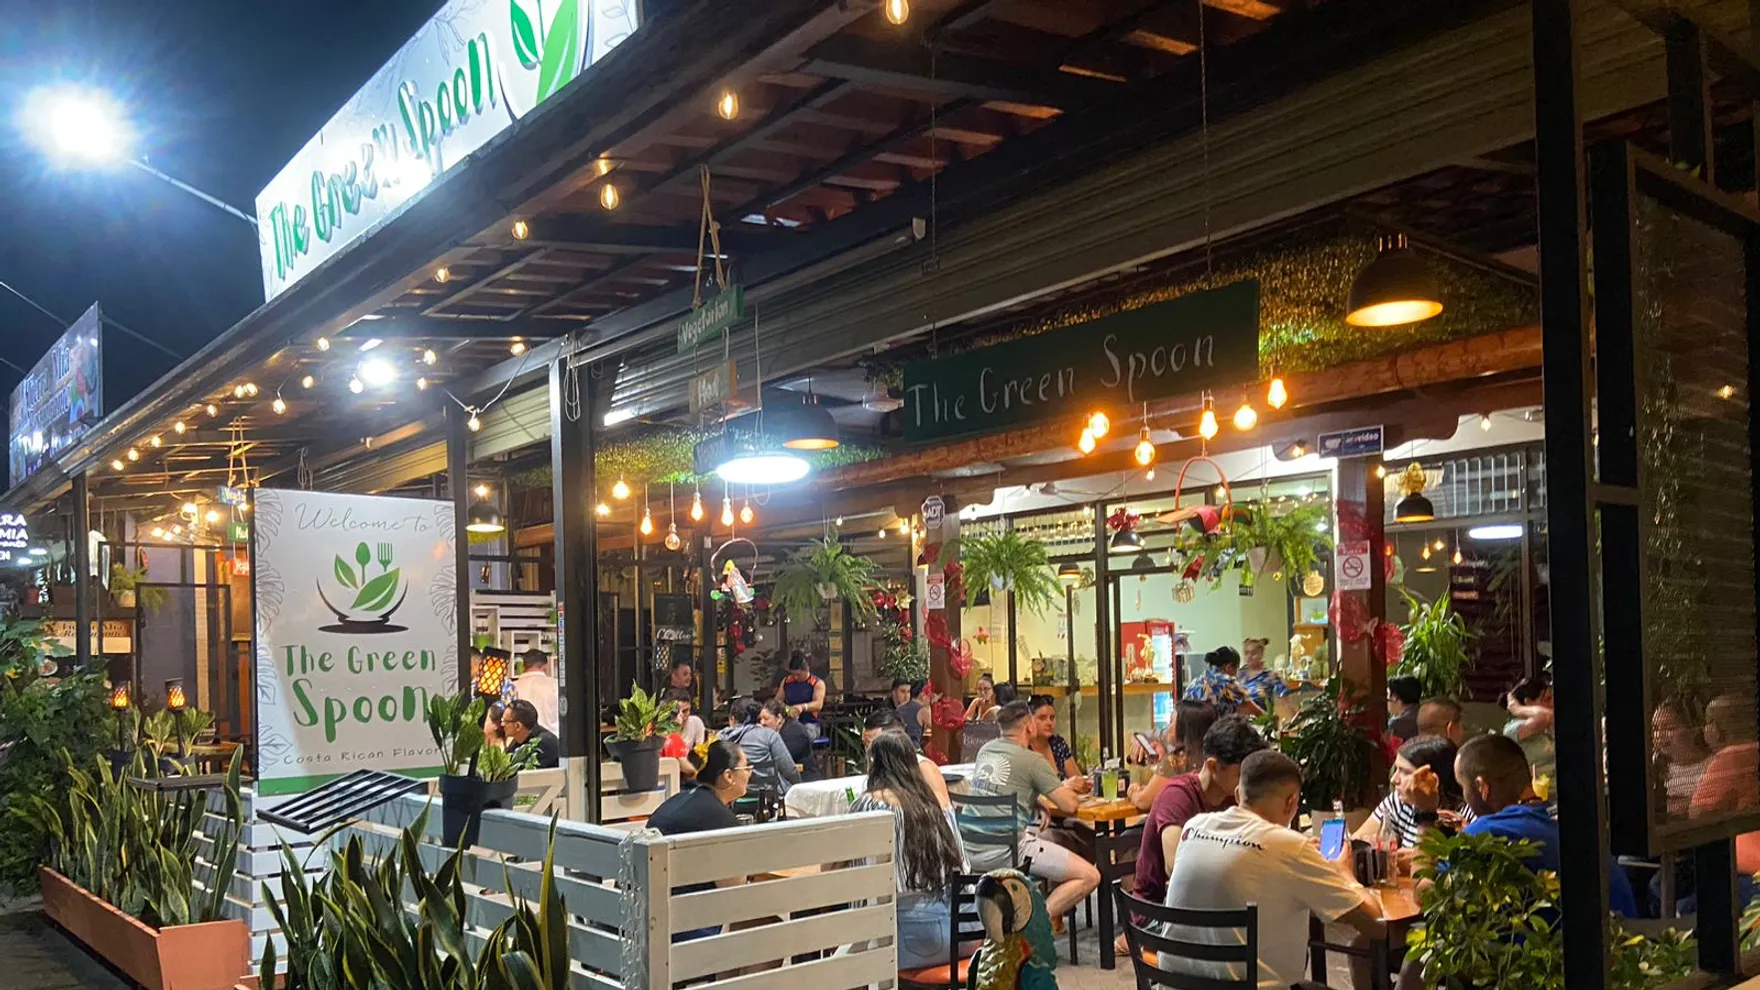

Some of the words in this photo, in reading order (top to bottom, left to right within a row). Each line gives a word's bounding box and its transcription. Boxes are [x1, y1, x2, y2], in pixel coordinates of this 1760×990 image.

[270, 200, 310, 281] The
[398, 31, 497, 166] Spoon
[906, 380, 966, 428] The
[979, 367, 1075, 414] Green
[1099, 333, 1215, 402] Spoon
[294, 503, 404, 531] Welcome
[402, 514, 435, 533] to
[280, 644, 336, 677] The
[347, 645, 436, 675] Green
[292, 678, 430, 743] Spoon
[283, 753, 331, 765] Costa
[341, 750, 384, 761] Rican
[1182, 827, 1266, 851] Champion
